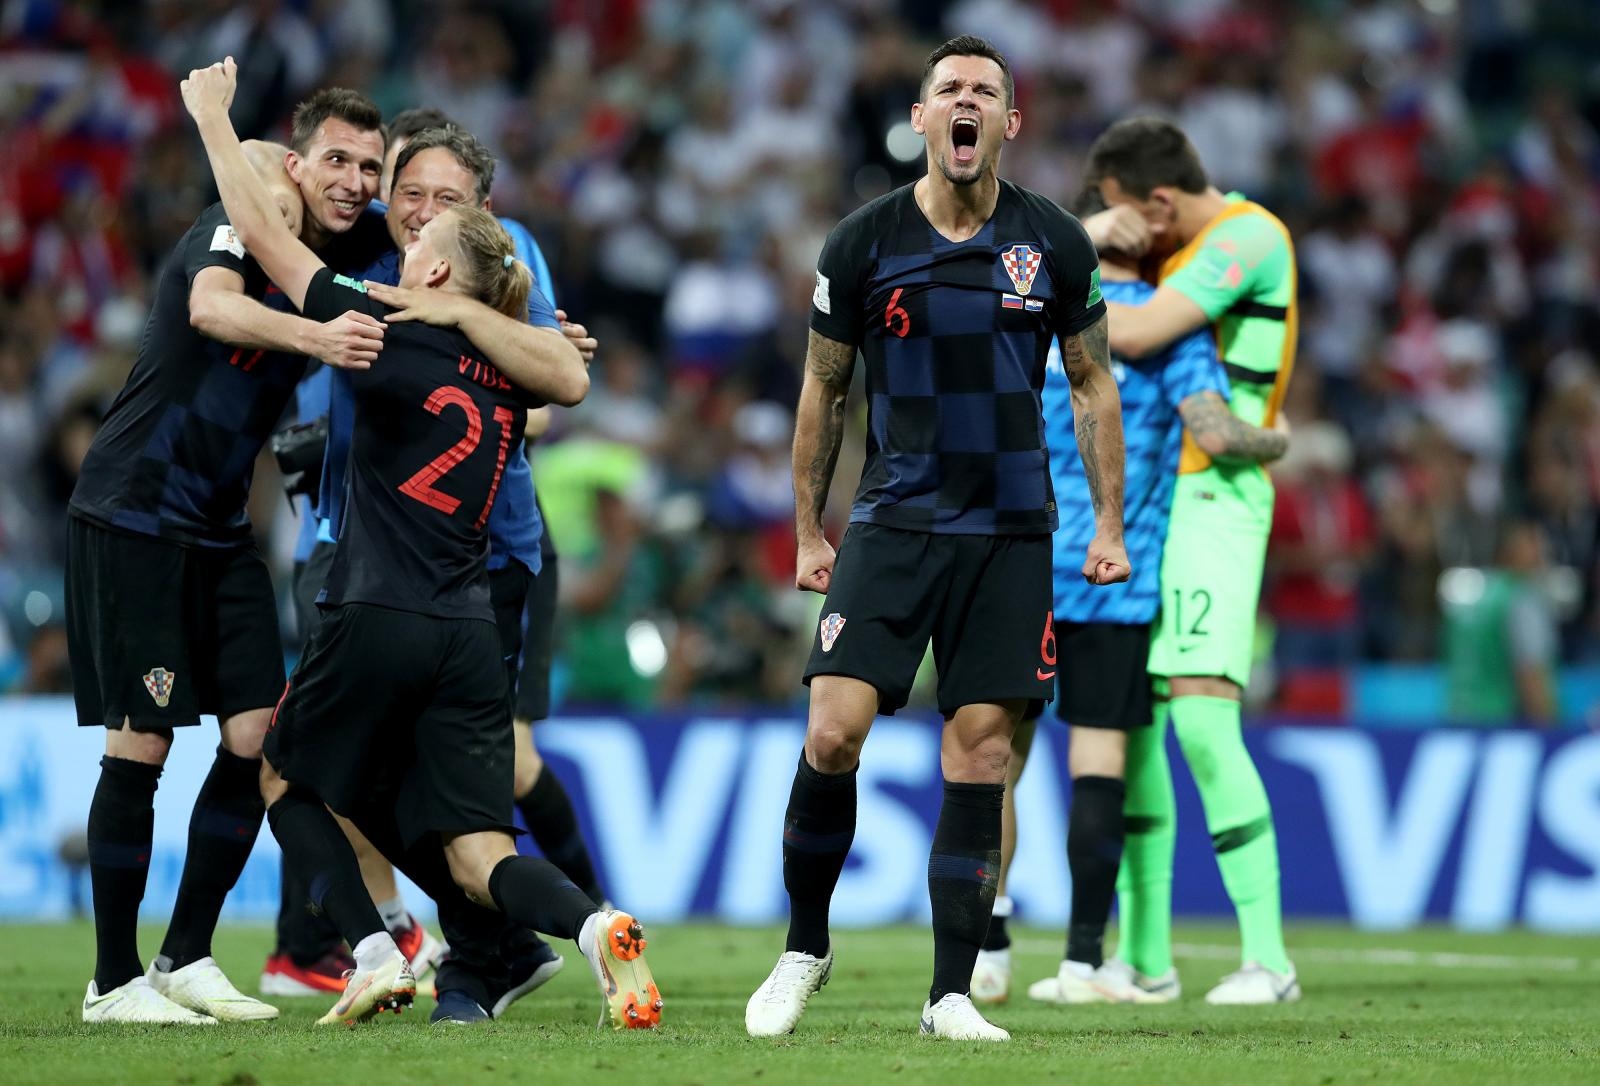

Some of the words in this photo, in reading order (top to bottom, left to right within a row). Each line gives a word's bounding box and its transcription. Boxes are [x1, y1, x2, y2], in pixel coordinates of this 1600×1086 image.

[885, 287, 910, 338] 6
[397, 385, 514, 529] 21
[1041, 610, 1057, 666] 6
[1174, 587, 1212, 636] 12
